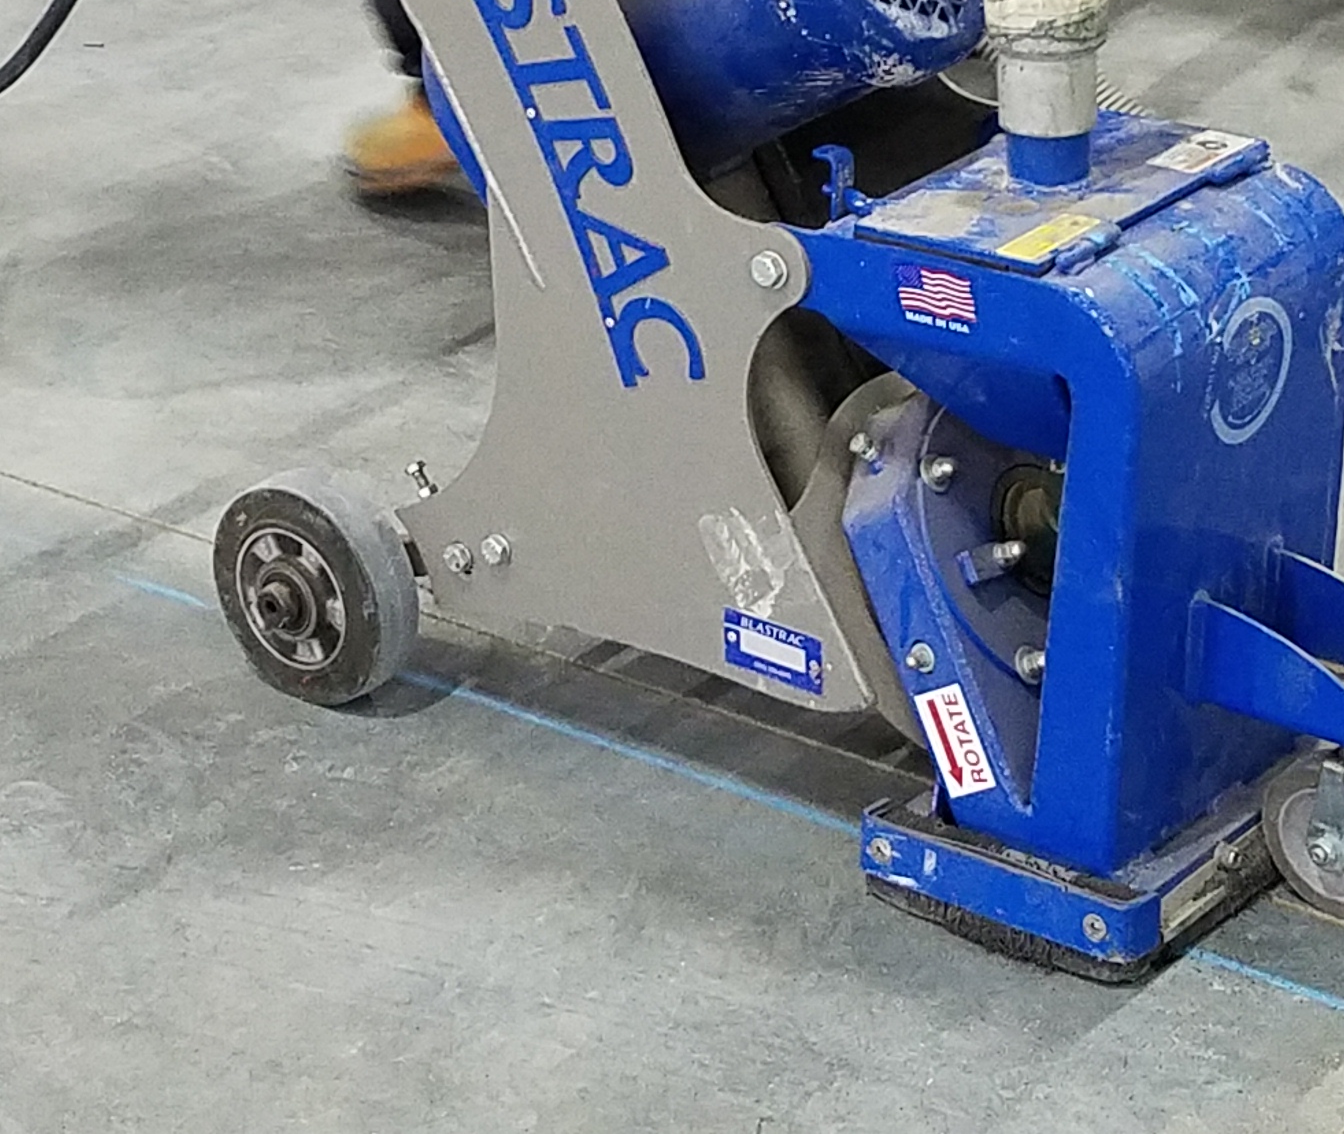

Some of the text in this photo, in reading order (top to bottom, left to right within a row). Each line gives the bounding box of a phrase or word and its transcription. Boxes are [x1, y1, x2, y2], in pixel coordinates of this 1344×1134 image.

[905, 310, 970, 334] MADE IN USA
[740, 616, 805, 647] BLASTRAC
[941, 693, 988, 783] ROTATE
